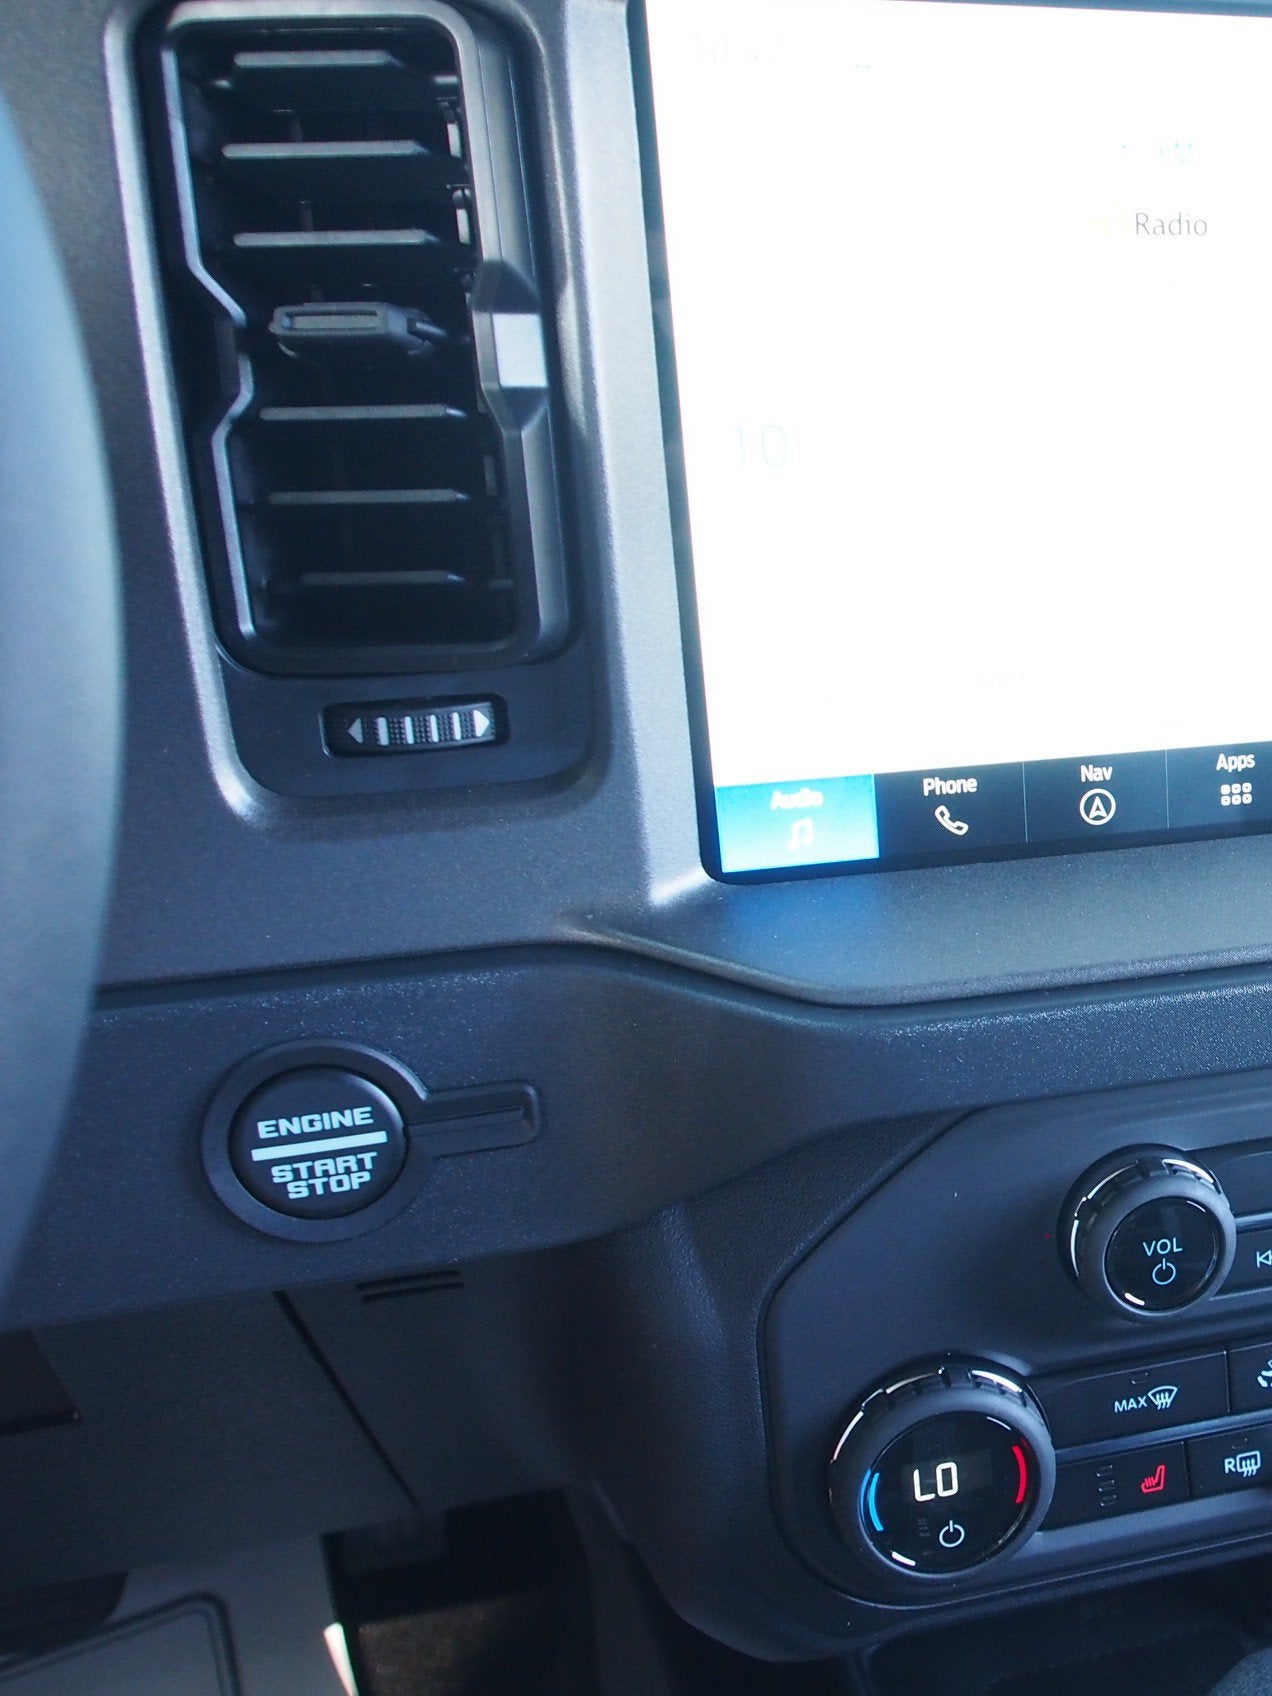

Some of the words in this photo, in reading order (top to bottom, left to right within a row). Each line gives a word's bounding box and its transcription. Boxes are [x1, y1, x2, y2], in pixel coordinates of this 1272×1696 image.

[1135, 210, 1208, 236] Radio
[1216, 752, 1255, 772] Apps
[1080, 764, 1113, 782] Nav
[923, 777, 978, 796] Phone
[771, 788, 824, 810] Audio
[256, 1106, 374, 1139] ENGINE
[271, 1151, 378, 1184] START
[286, 1171, 372, 1200] STOP
[1142, 1237, 1183, 1257] VOL
[1114, 1395, 1148, 1414] MAX
[1223, 1457, 1236, 1474] R
[912, 1460, 959, 1503] LO
